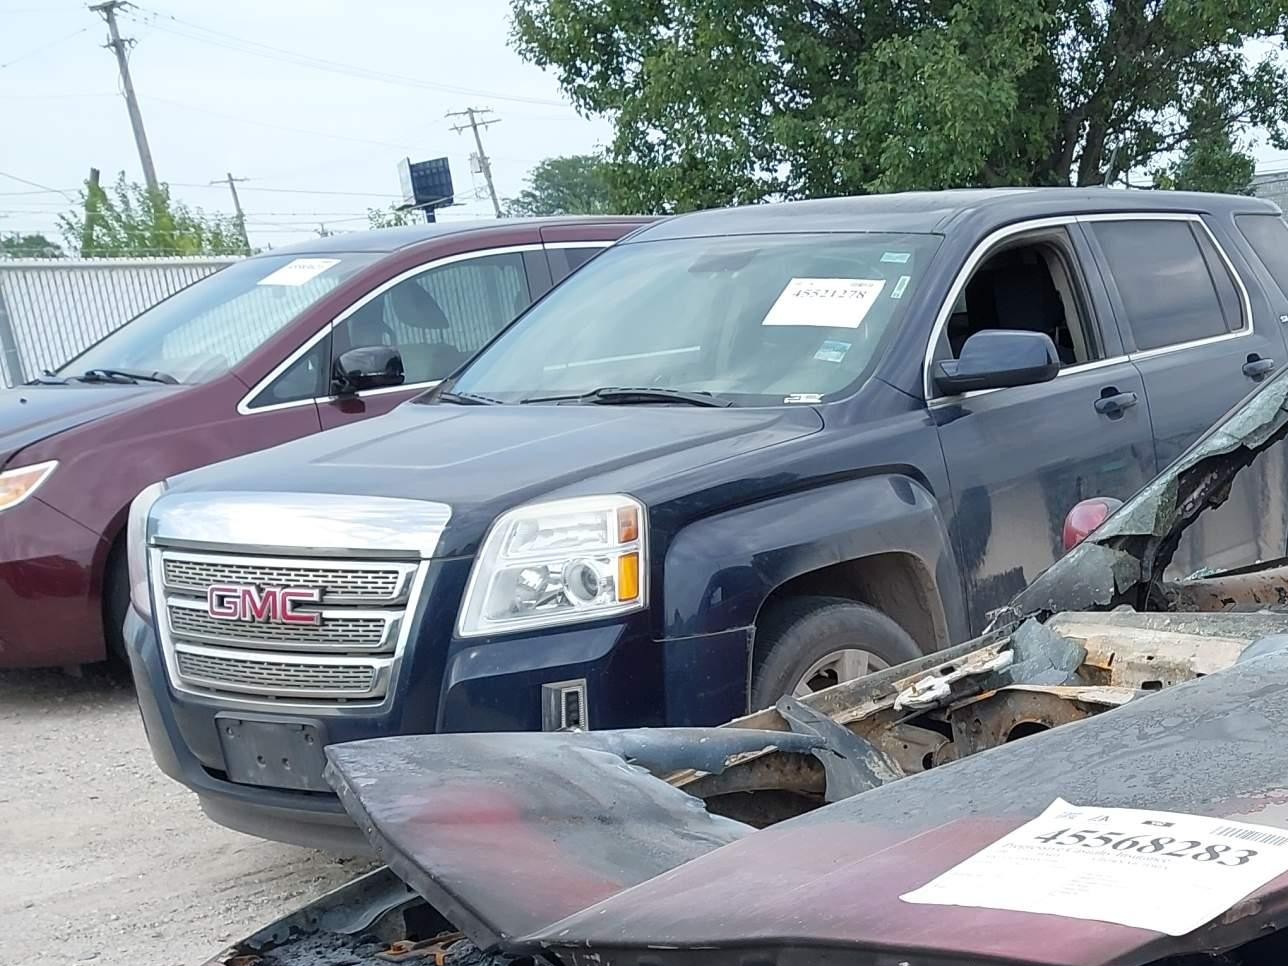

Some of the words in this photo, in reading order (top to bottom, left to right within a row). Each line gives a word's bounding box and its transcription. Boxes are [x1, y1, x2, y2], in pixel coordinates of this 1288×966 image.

[793, 289, 867, 299] 45521278
[208, 584, 320, 625] GMC
[1034, 827, 1258, 866] 45568283
